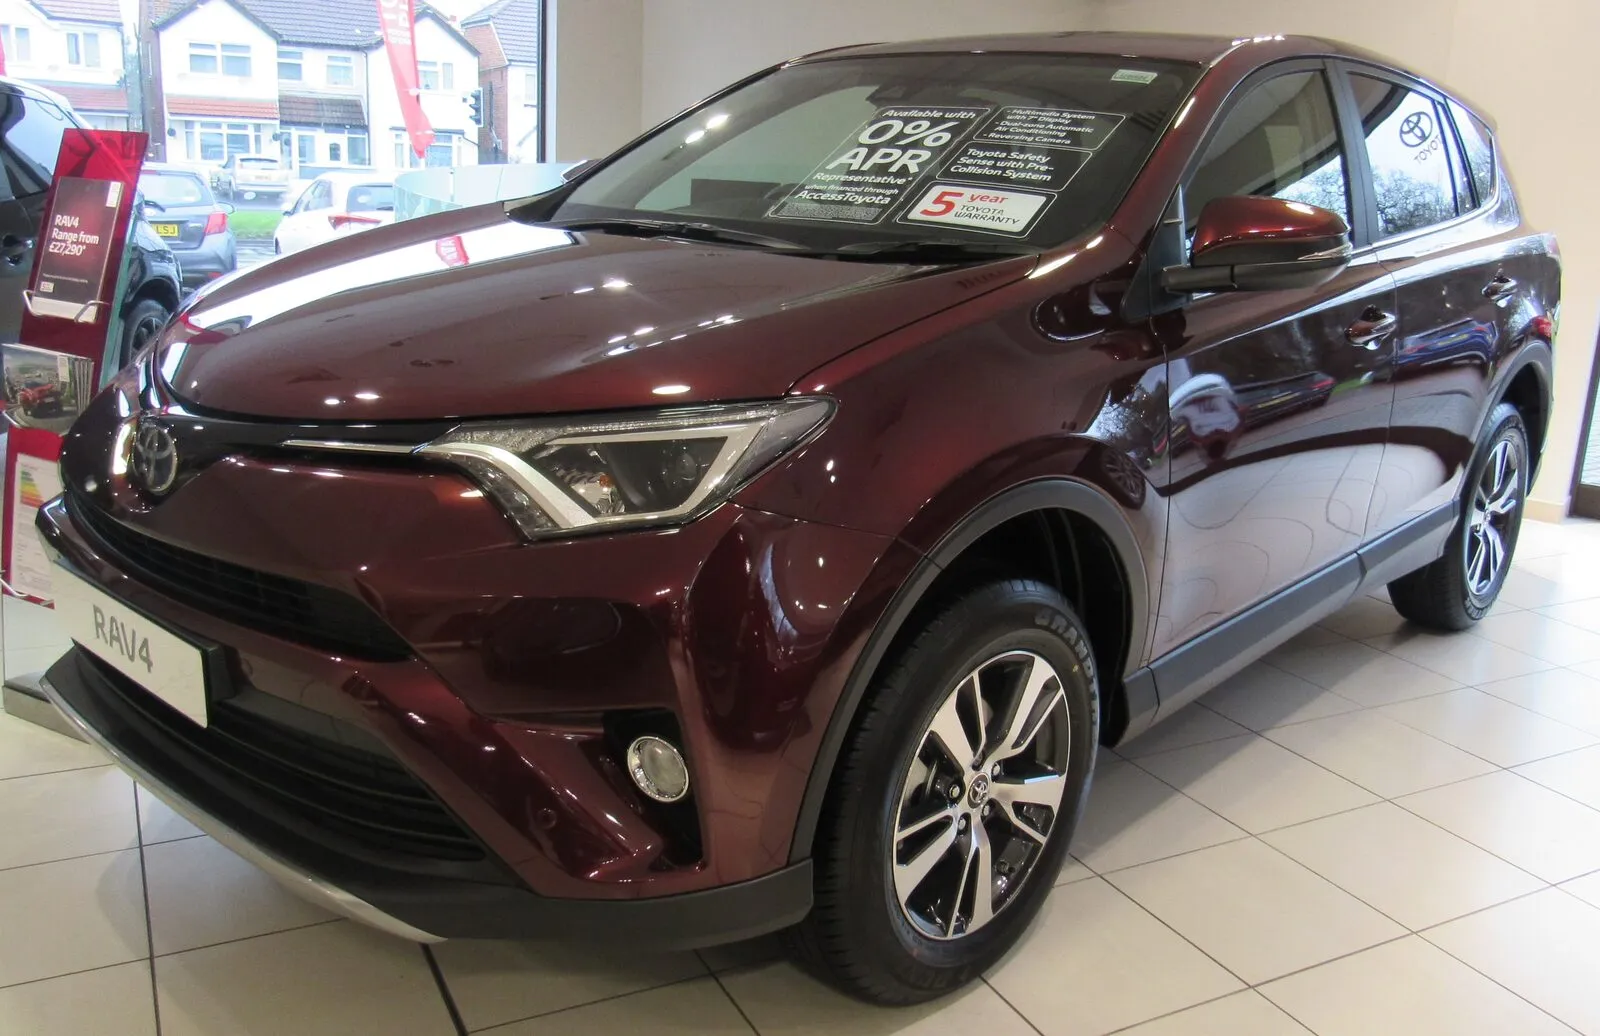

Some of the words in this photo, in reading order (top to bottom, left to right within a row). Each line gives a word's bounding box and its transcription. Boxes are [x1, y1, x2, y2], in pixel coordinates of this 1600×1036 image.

[882, 109, 942, 118] Available
[944, 111, 976, 119] with
[1011, 109, 1060, 117] Multimedia
[1060, 112, 1096, 120] System
[1038, 116, 1072, 125] Display
[858, 119, 960, 147] 0%
[1009, 127, 1067, 137] Conditioning
[1045, 124, 1095, 133] Automatic
[988, 132, 1034, 142] Reversing
[1035, 136, 1071, 144] Camera
[966, 148, 1006, 158] Toyota
[1007, 151, 1051, 163] Safety
[1413, 134, 1442, 164] TOYOT
[825, 147, 932, 174] APR
[957, 156, 996, 166] Sense
[996, 160, 1025, 169] with
[950, 165, 1002, 176] Collision
[1002, 169, 1052, 181] System
[794, 190, 891, 204] AccessToyota
[826, 185, 865, 193] financed
[863, 187, 899, 195] through
[920, 191, 965, 217] 5
[967, 193, 1009, 205] year
[960, 204, 1004, 215] TOYOTA
[54, 214, 80, 228] RAV4
[954, 211, 1020, 225] WARRANTY
[52, 228, 78, 244] Range
[78, 231, 100, 245] from
[92, 603, 154, 674] RAV4
